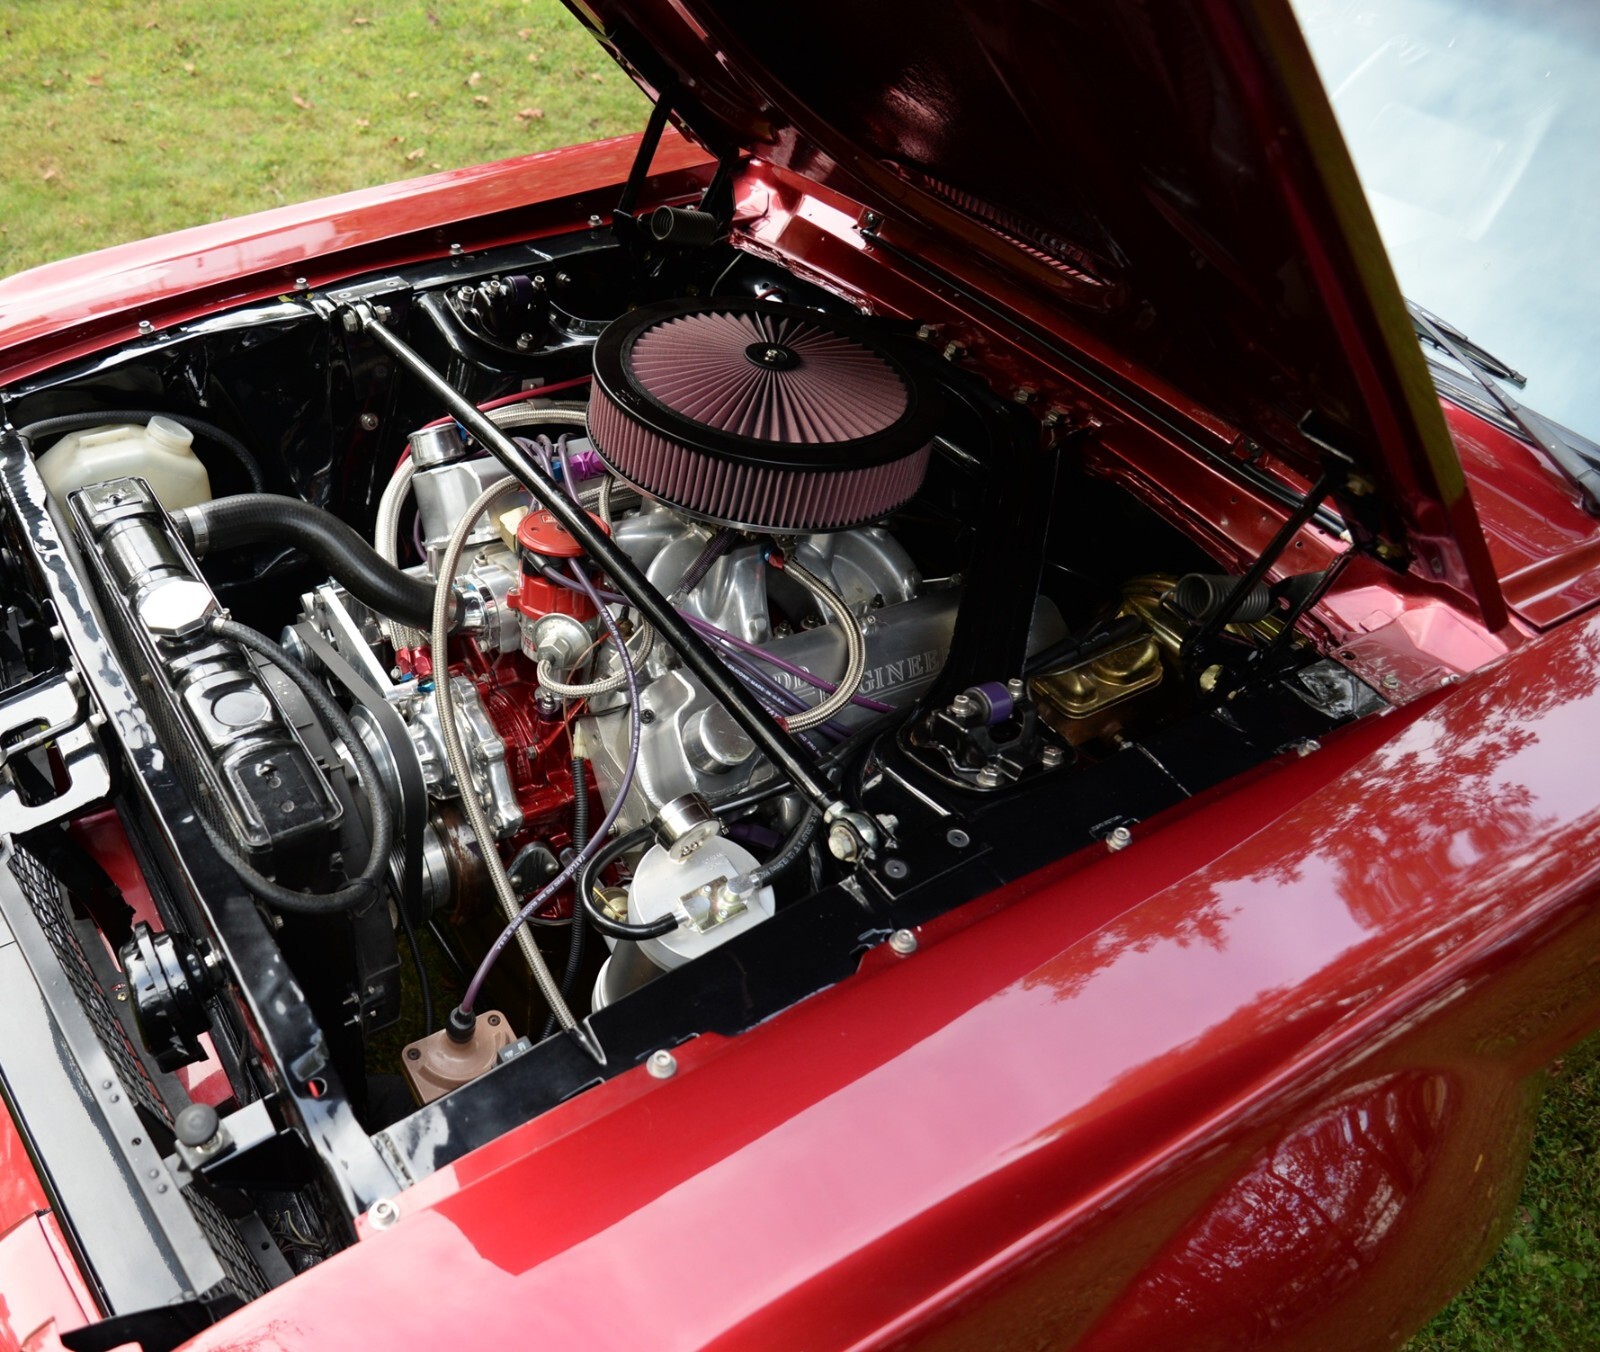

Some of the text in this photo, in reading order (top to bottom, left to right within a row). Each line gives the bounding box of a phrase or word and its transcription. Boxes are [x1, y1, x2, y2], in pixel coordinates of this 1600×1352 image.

[600, 607, 618, 636] TAYLOR
[750, 680, 765, 692] MADE
[565, 854, 586, 876] TAYLOR
[511, 917, 523, 930] MADE
